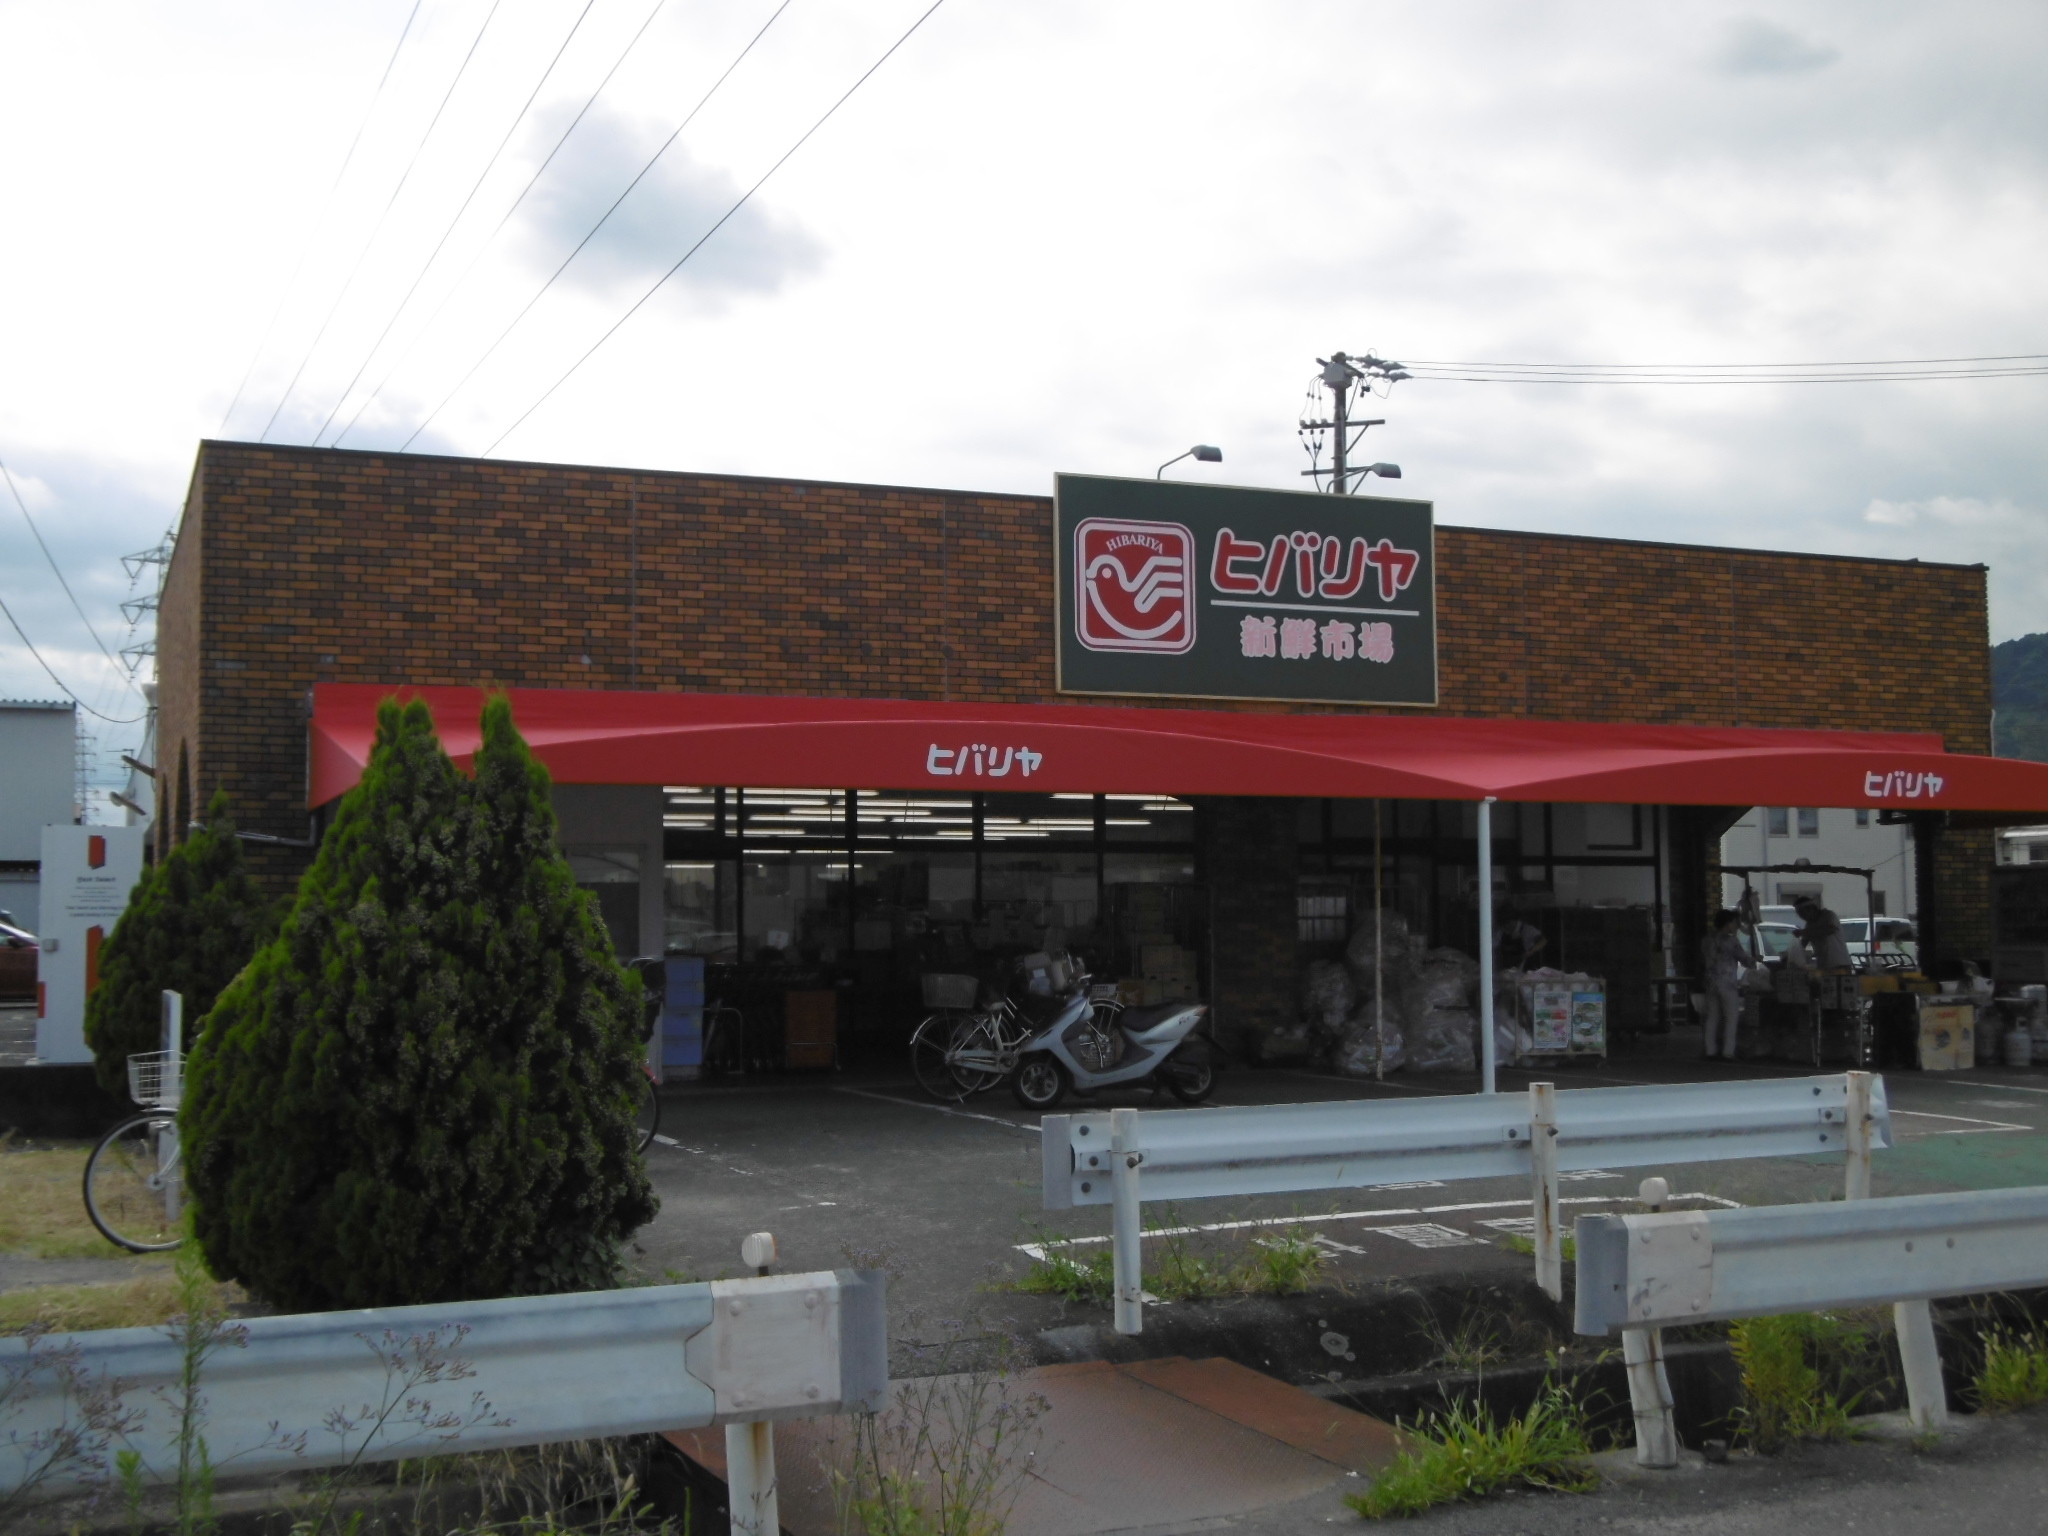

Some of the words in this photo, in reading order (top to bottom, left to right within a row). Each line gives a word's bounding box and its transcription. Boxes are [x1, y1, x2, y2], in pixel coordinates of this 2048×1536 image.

[1106, 534, 1163, 555] HIBARIYA
[1210, 527, 1420, 602] ヒバリヤ
[1240, 614, 1394, 663] 新鮮市場
[926, 743, 1043, 777] ヒバリヤ
[1864, 770, 1944, 798] ヒバリヤ
